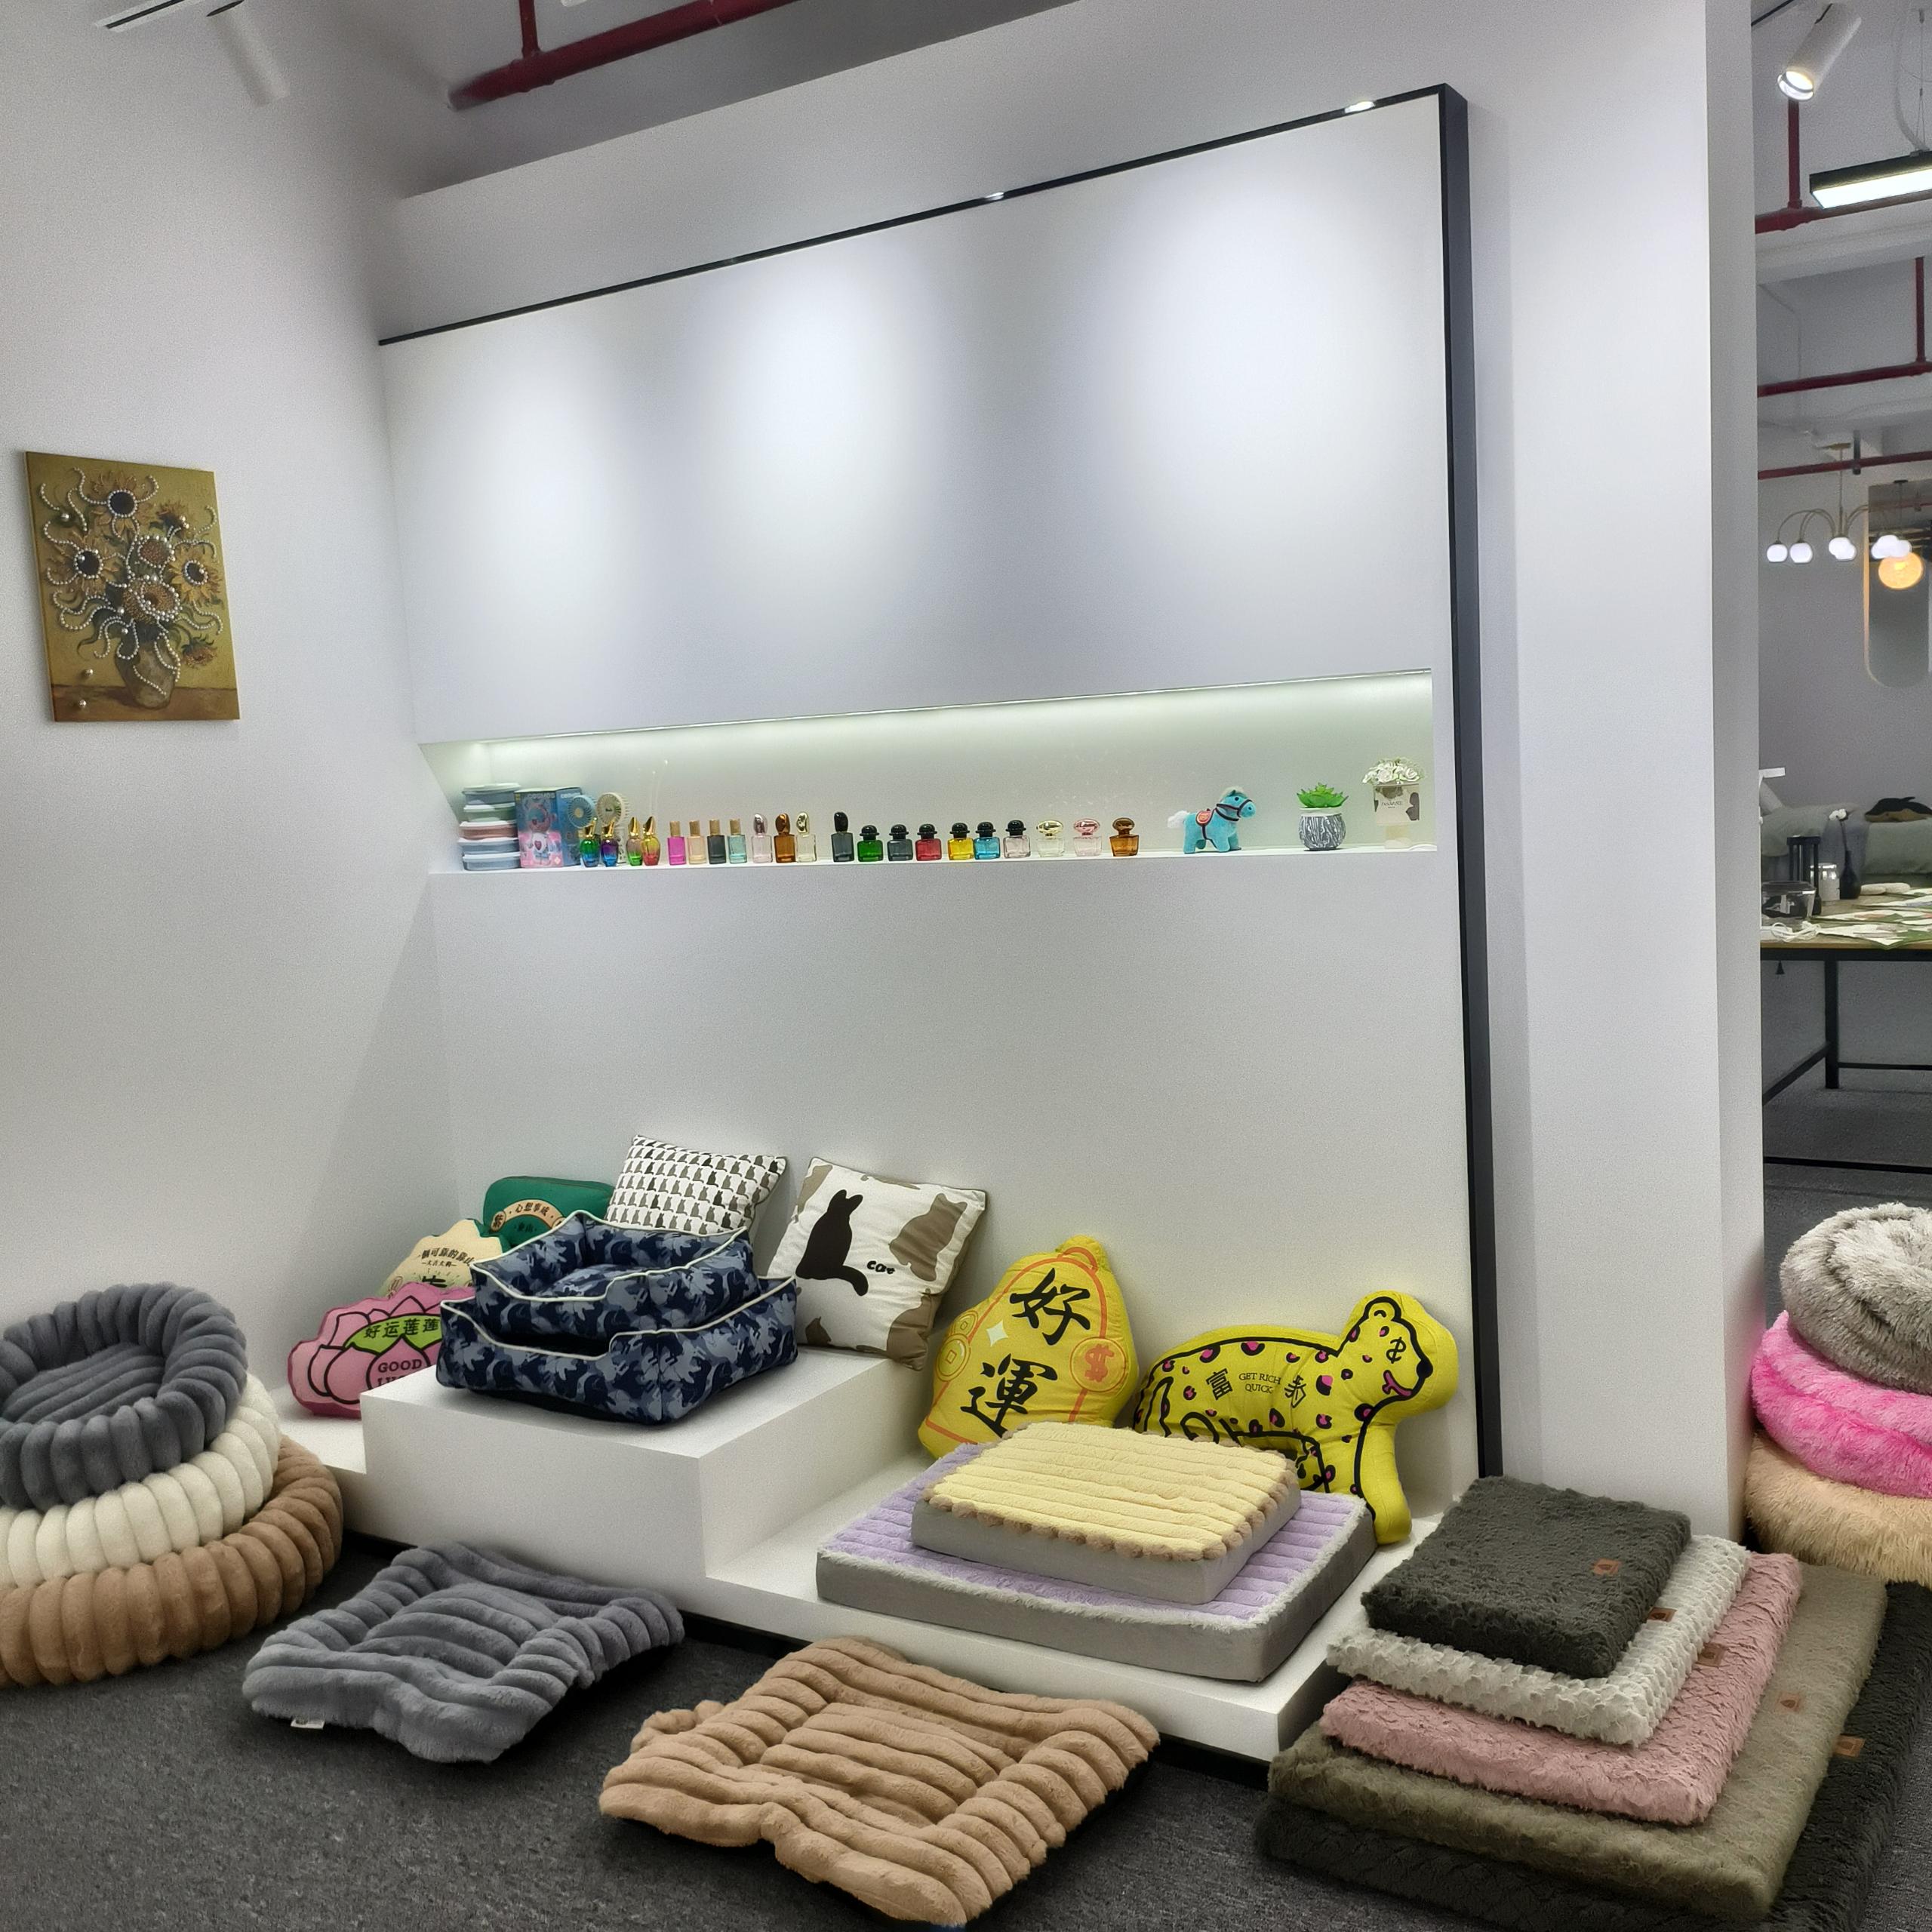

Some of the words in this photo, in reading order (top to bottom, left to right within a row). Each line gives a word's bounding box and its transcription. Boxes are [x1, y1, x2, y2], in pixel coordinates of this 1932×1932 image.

[363, 1318, 440, 1338] 好运莲莲
[377, 1358, 423, 1374] GOOD
[1205, 1367, 1233, 1401] 富
[1238, 1372, 1258, 1381] GET
[1258, 1373, 1281, 1385] RICH
[1244, 1383, 1273, 1394] QUICK
